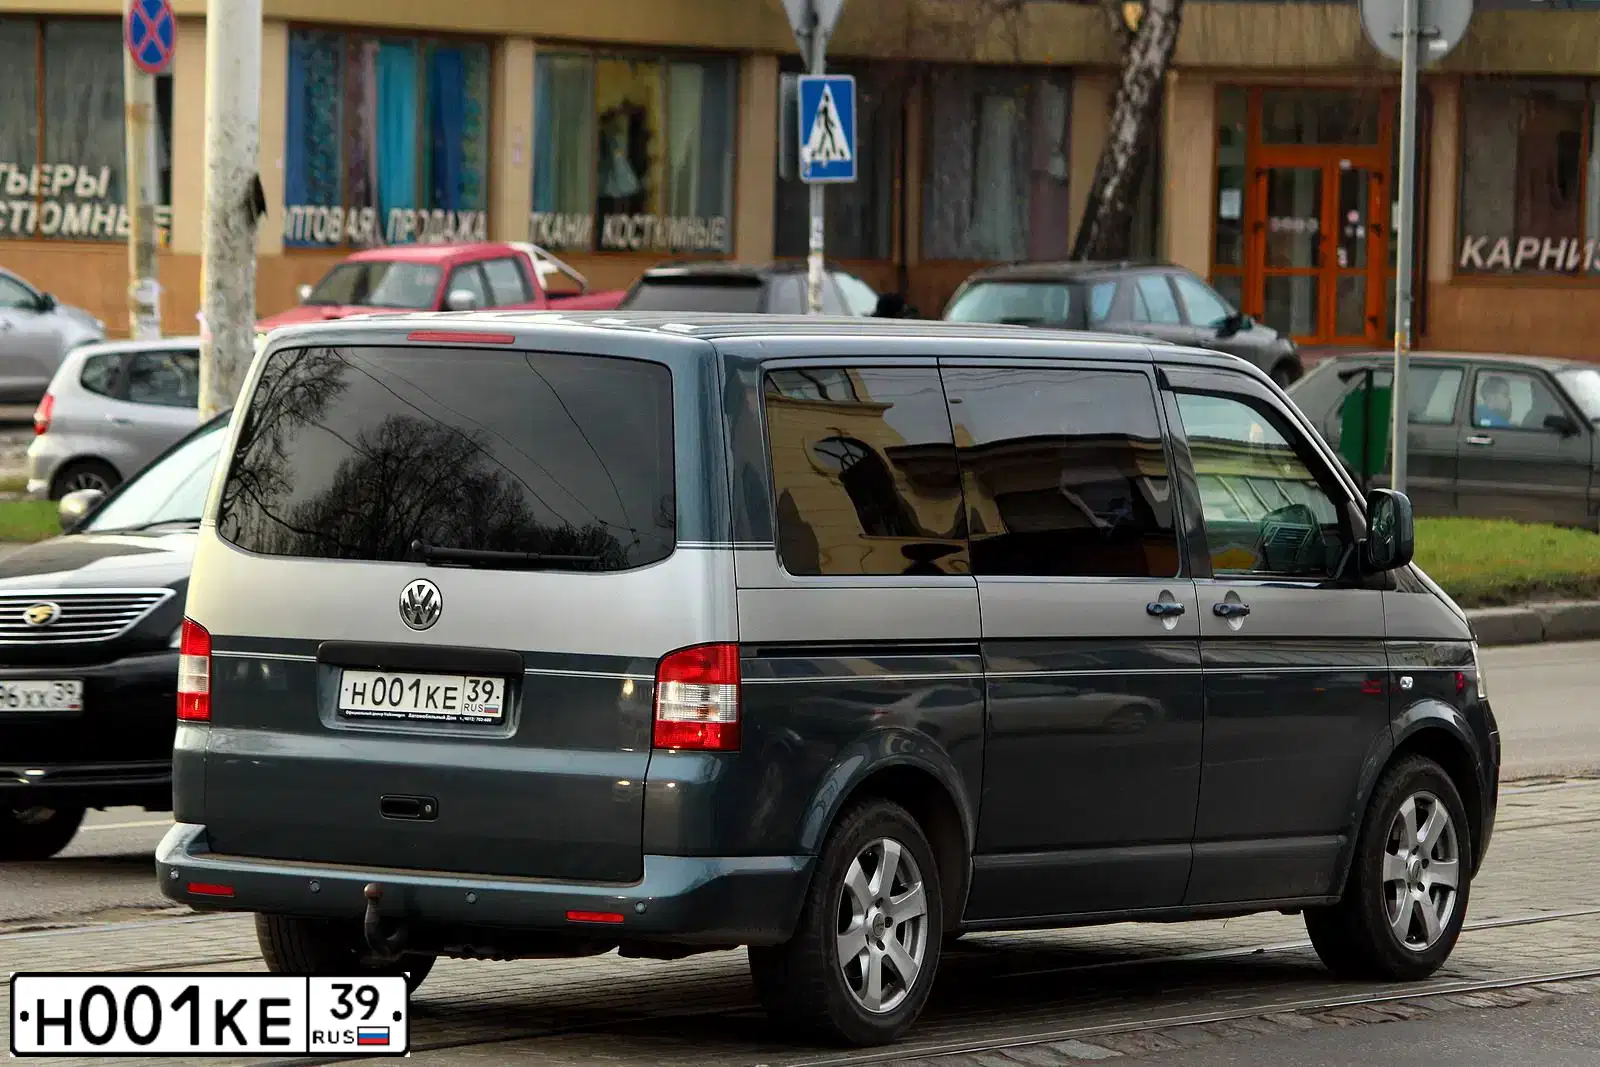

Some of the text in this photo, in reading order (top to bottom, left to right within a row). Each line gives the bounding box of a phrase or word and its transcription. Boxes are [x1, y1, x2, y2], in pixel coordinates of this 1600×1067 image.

[386, 207, 488, 243] ПРОДАЖА
[601, 213, 727, 248] КОСТЮМНЫЕ
[351, 676, 494, 710] Н001КЕ 39
[463, 703, 484, 713] RUS
